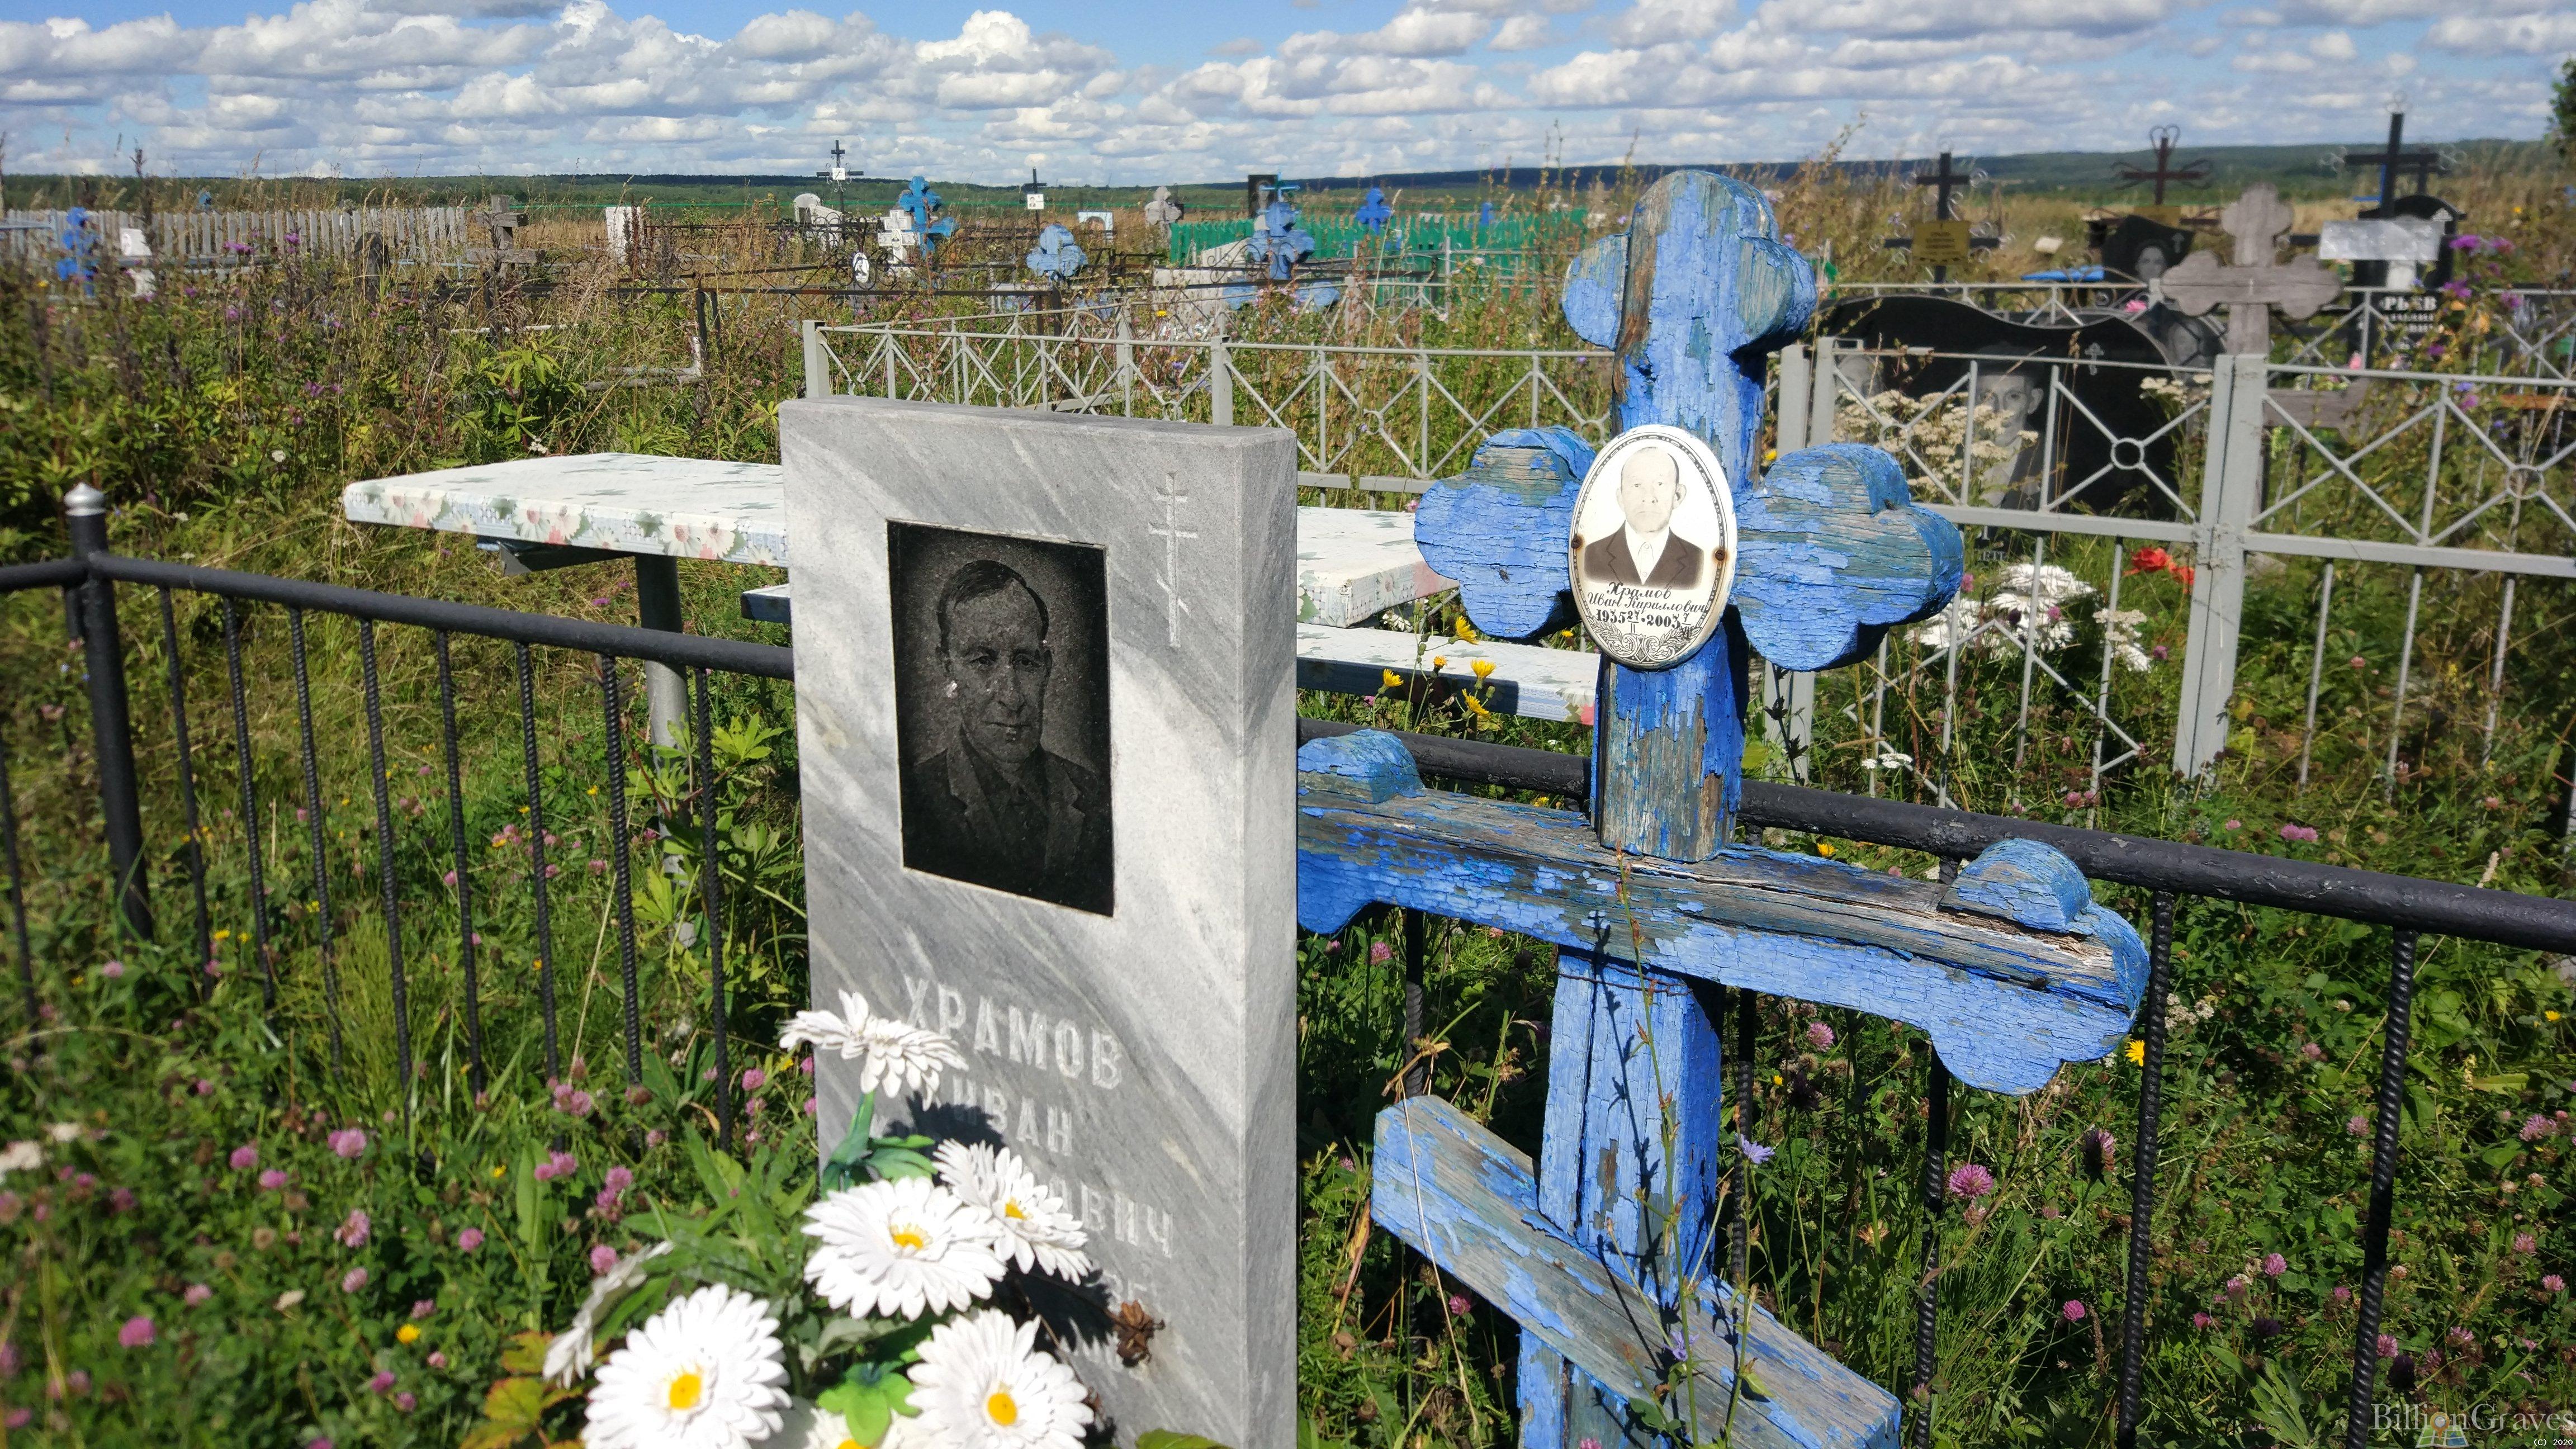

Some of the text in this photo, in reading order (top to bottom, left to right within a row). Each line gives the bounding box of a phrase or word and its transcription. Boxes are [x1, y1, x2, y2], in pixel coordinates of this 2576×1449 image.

[1587, 592, 1706, 614] Иван Кириллович
[1607, 582, 1673, 599] Храмов
[903, 973, 1123, 1090] ХРАМОВ
[952, 1074, 1073, 1157] ИВАН
